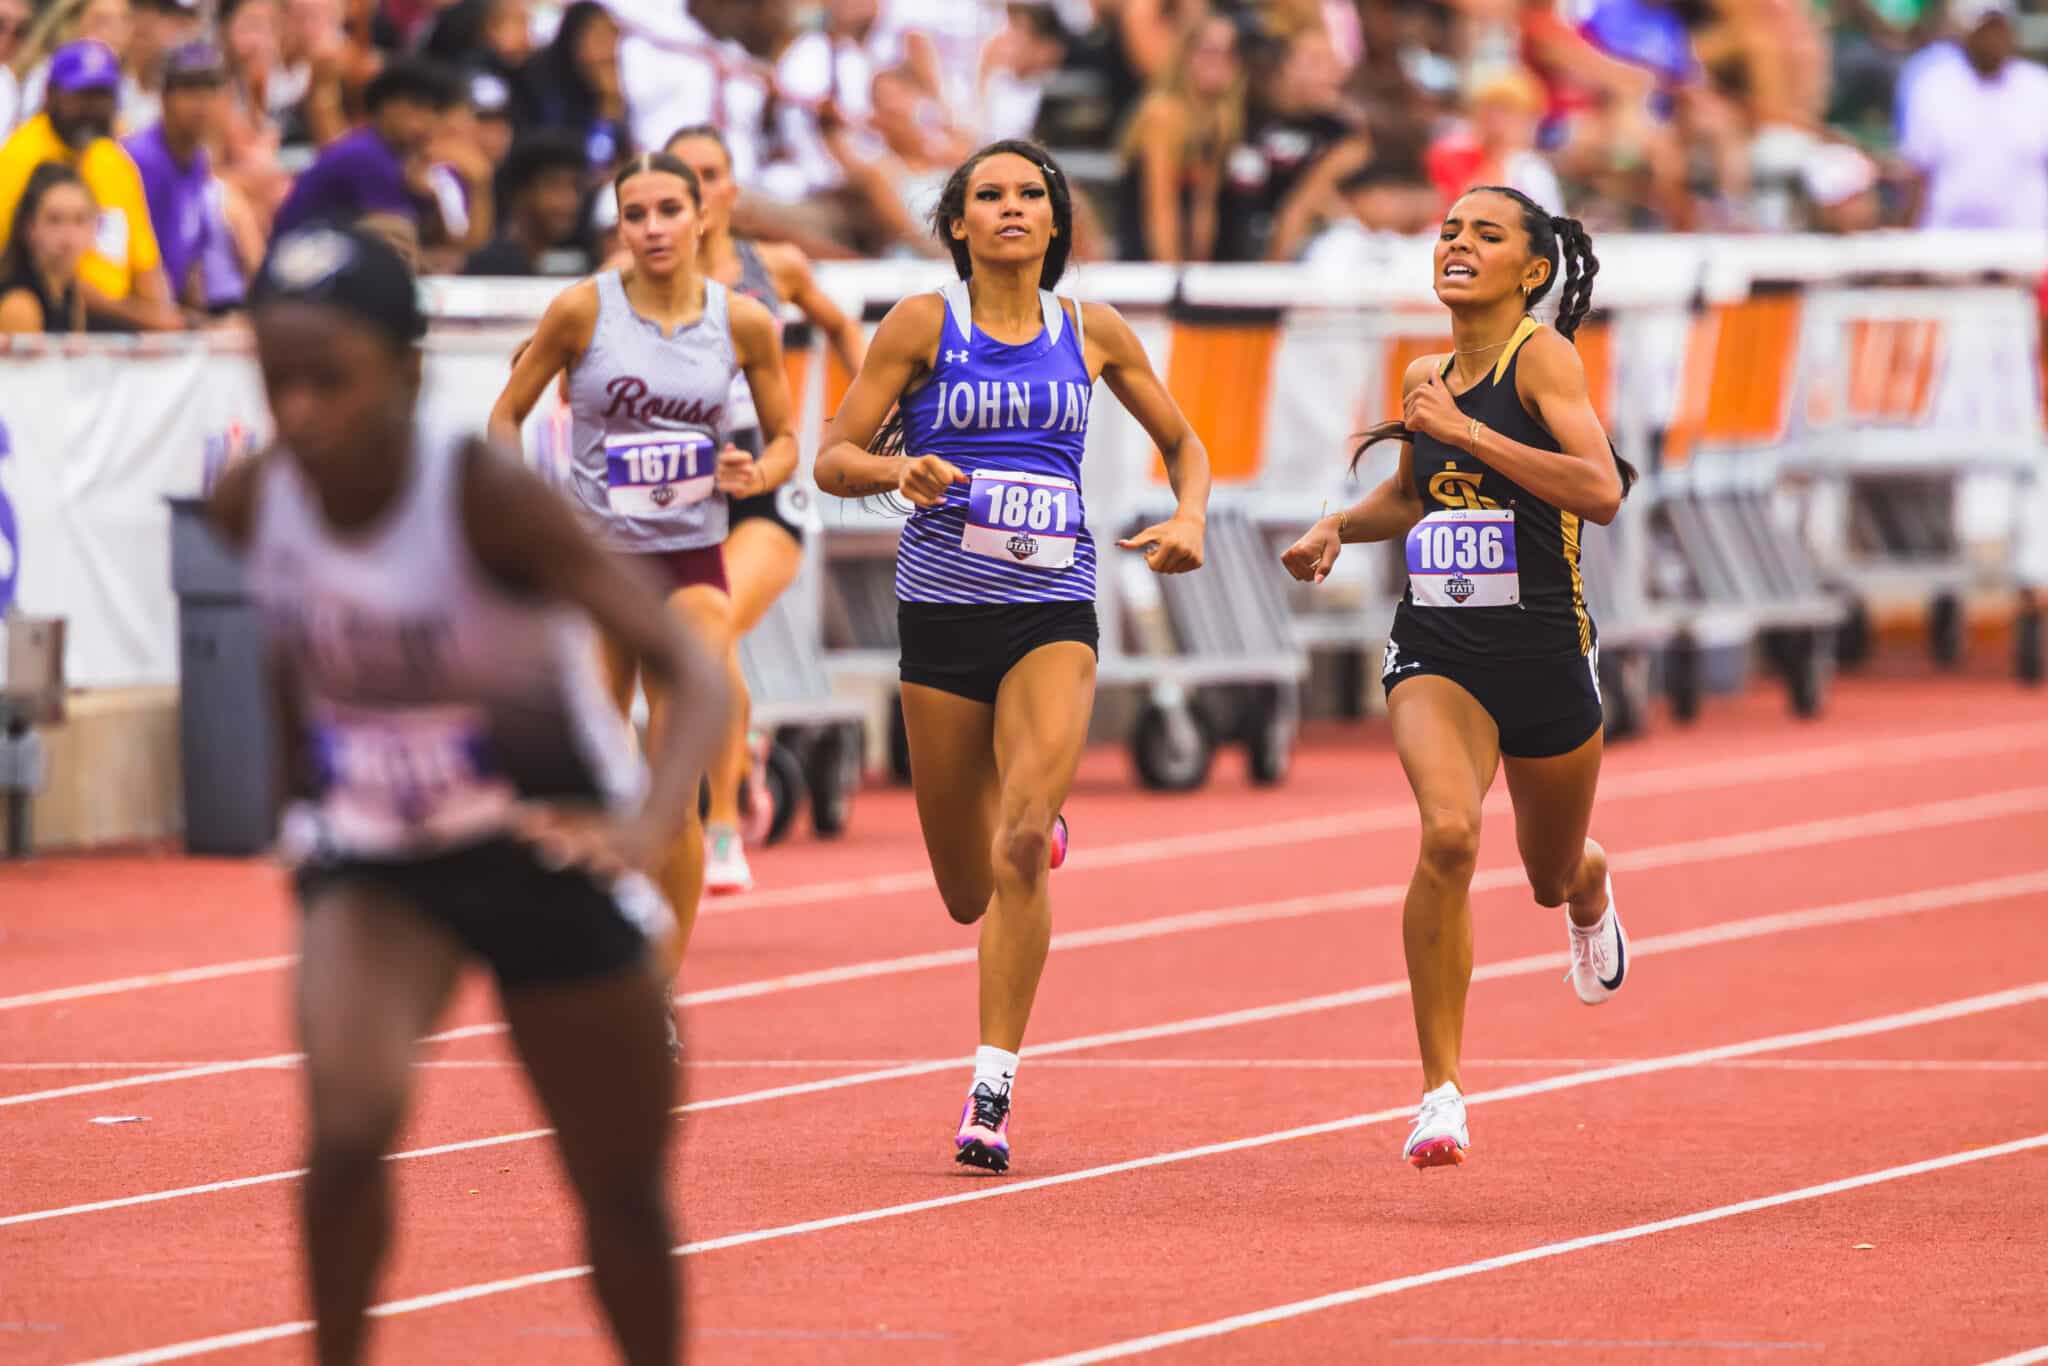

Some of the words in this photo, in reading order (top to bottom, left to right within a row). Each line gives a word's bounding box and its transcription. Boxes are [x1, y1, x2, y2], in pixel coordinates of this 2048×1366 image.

[601, 376, 724, 425] Rouse
[931, 381, 1030, 429] JOHN
[622, 443, 698, 483] 1671
[986, 484, 1067, 532] 1881
[1007, 541, 1038, 552] STATE
[1417, 526, 1504, 569] 1036
[1445, 584, 1474, 593] STATE
